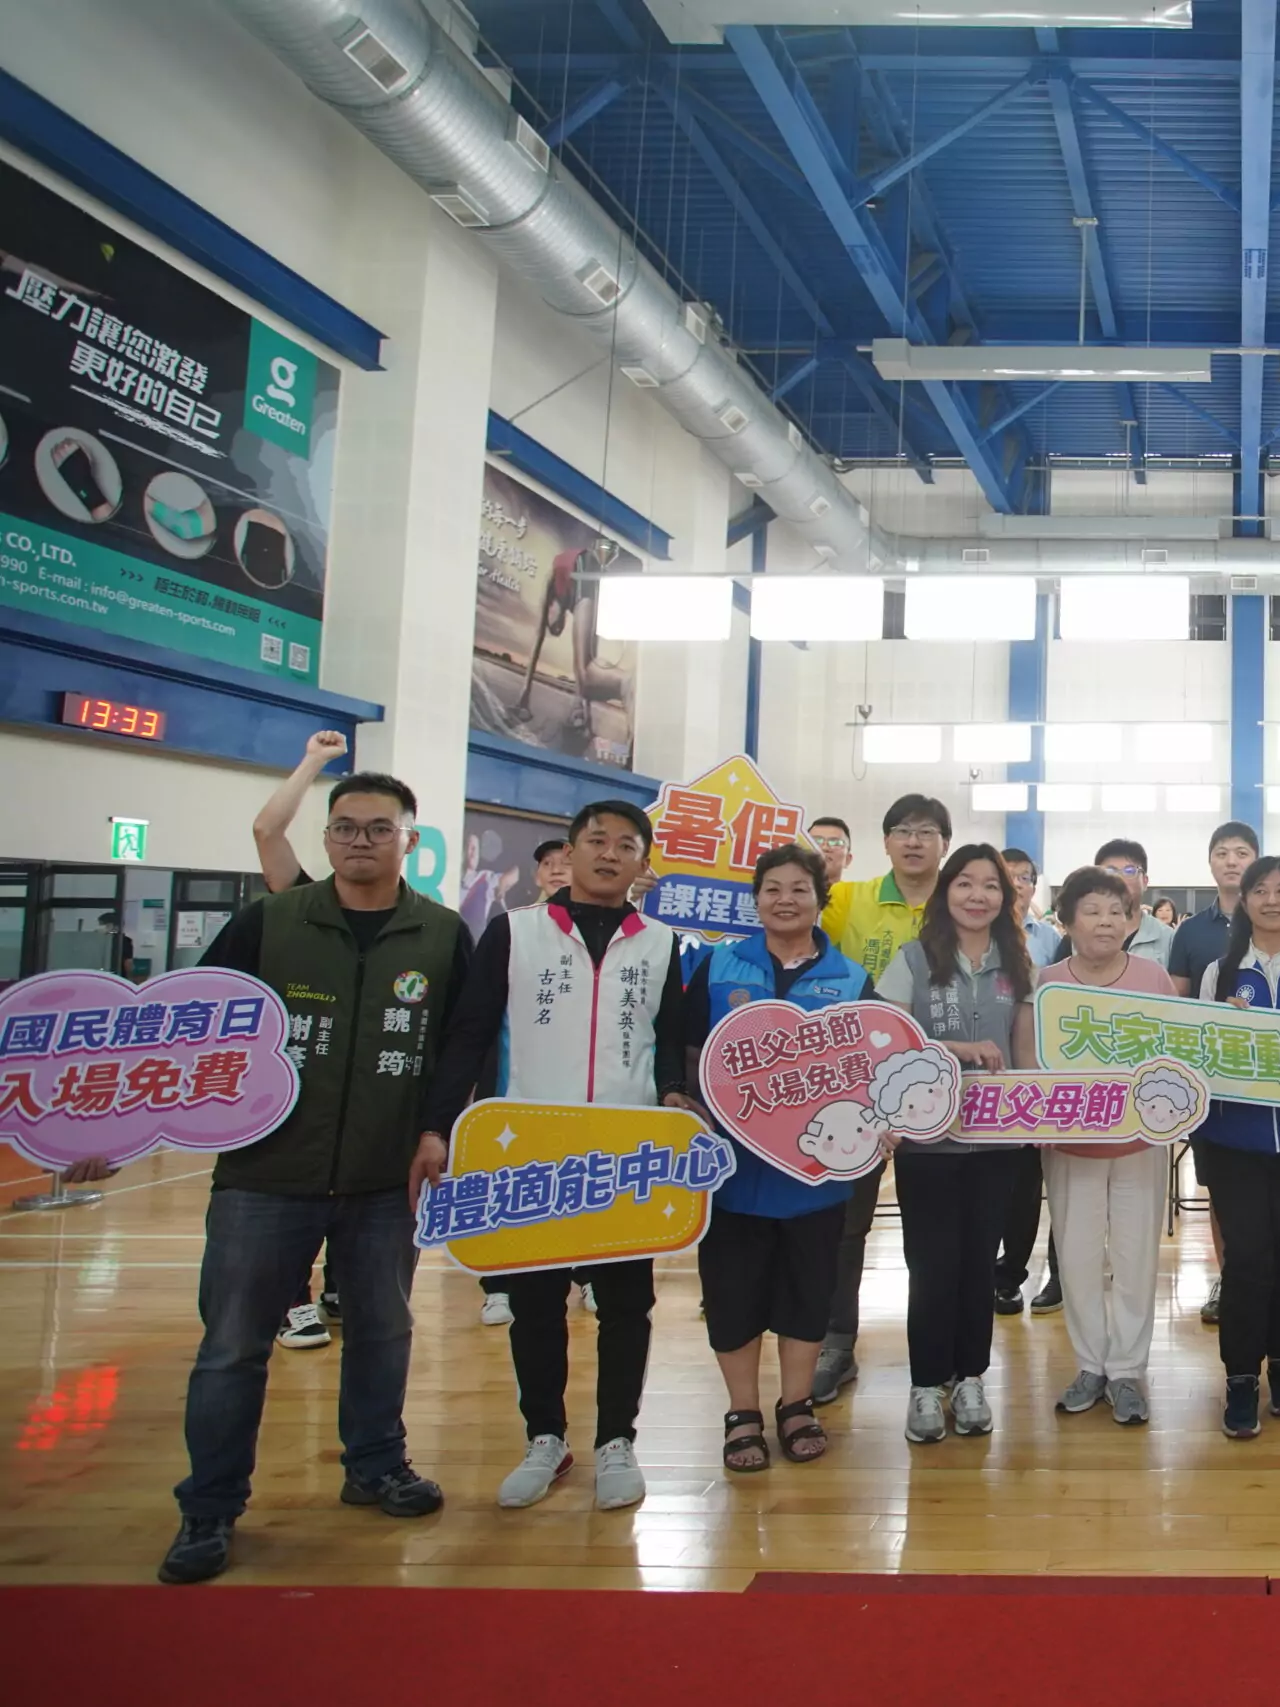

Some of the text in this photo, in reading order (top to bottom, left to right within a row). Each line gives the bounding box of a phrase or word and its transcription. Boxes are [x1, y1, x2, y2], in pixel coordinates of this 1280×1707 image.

[5, 268, 209, 395] 壓力讓您激發
[69, 340, 222, 440] 更好的自己
[251, 394, 306, 436] Greaten
[38, 566, 82, 591] E-mail
[80, 700, 159, 738] 13:33
[654, 789, 799, 868] 暑假
[286, 983, 310, 992] TEAM
[286, 991, 330, 1002] ZHONGLI
[558, 954, 574, 994] 副主任
[618, 966, 640, 1031] 謝美英
[0, 997, 265, 1058] 國民體育日
[315, 1016, 333, 1056] 副主任
[721, 1010, 865, 1077] 祖父母節
[0, 1050, 250, 1119] 入場免費
[737, 1051, 875, 1121] 入場免費
[960, 1080, 1132, 1132] 祖父母節
[421, 1132, 733, 1243] 體適能中心
